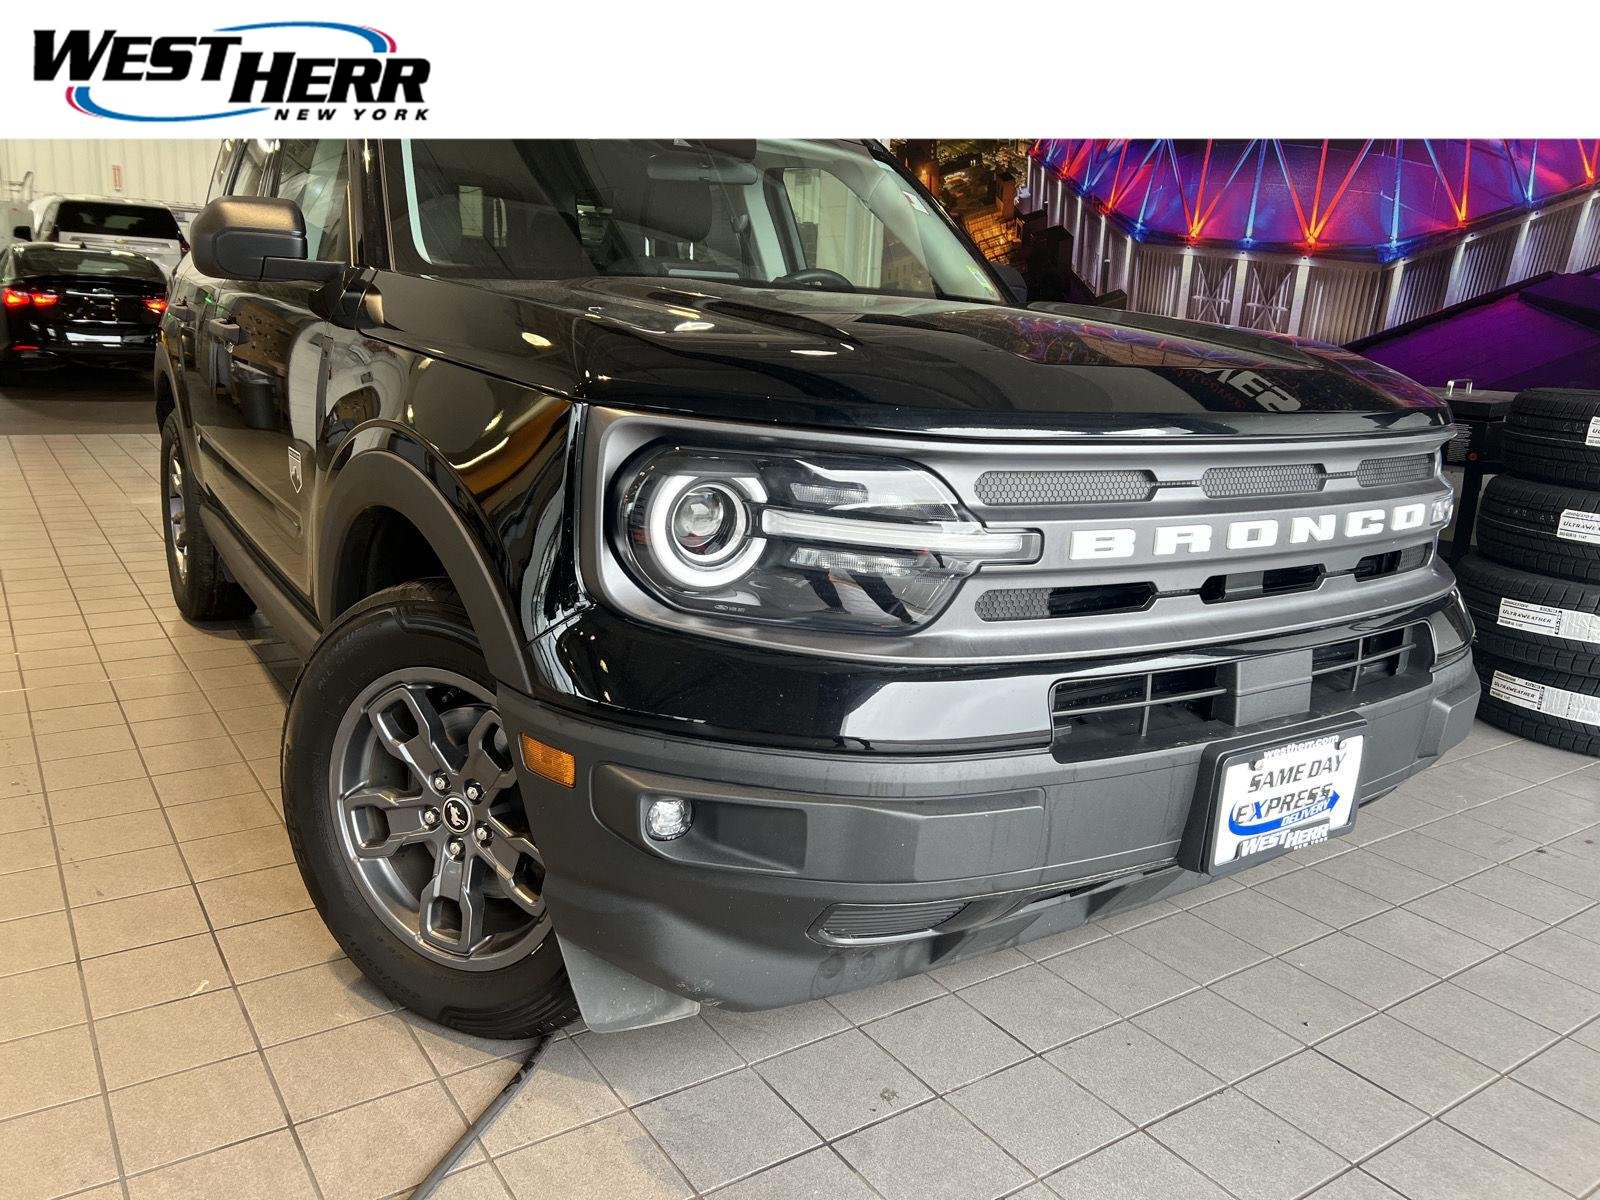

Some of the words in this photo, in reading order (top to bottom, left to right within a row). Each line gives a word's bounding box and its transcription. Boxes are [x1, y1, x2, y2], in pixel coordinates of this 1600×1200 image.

[1068, 502, 1427, 560] BRONCO
[1502, 609, 1552, 623] ULTRAWEATHER
[1247, 763, 1307, 793] SAME
[1307, 752, 1347, 778] DAY
[1235, 782, 1333, 824] EXPRESS
[1280, 799, 1330, 827] DELIVERY
